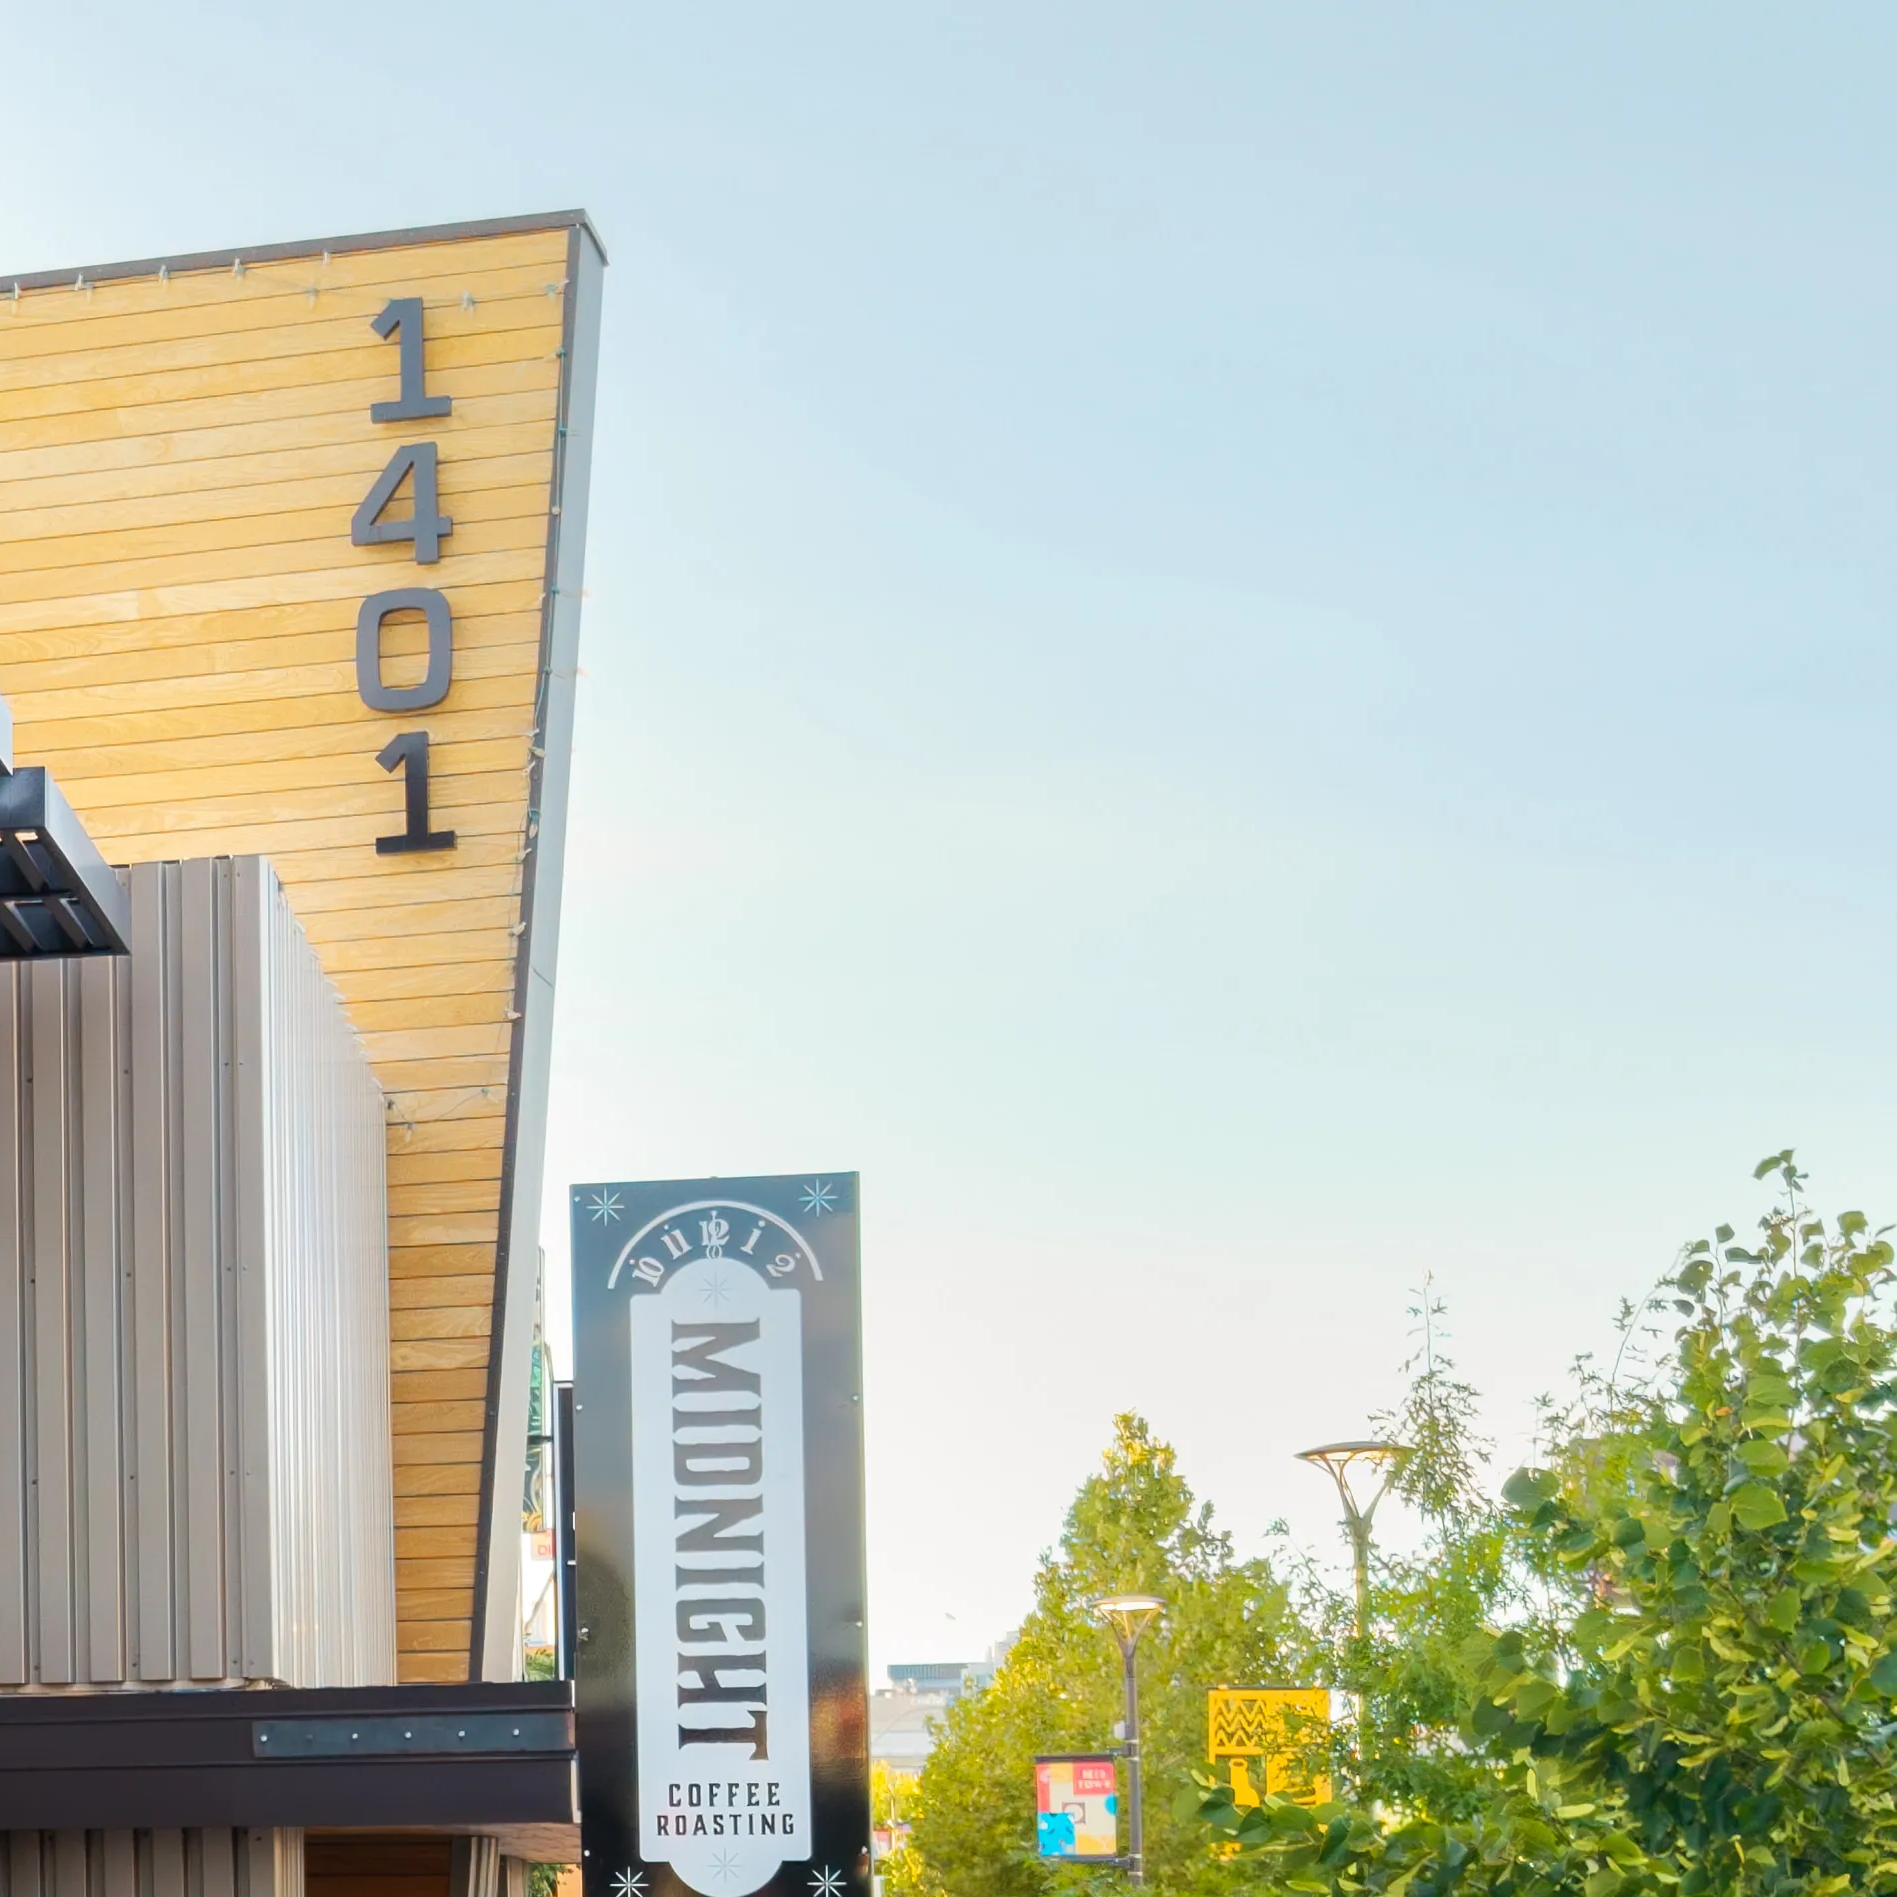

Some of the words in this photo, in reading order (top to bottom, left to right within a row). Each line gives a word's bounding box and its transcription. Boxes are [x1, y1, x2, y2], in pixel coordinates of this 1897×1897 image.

[351, 297, 457, 856] 1401
[671, 1317, 769, 1761] MIDNIGHT
[656, 1813, 794, 1836] ROASTING
[668, 1782, 780, 1807] COFFEE
